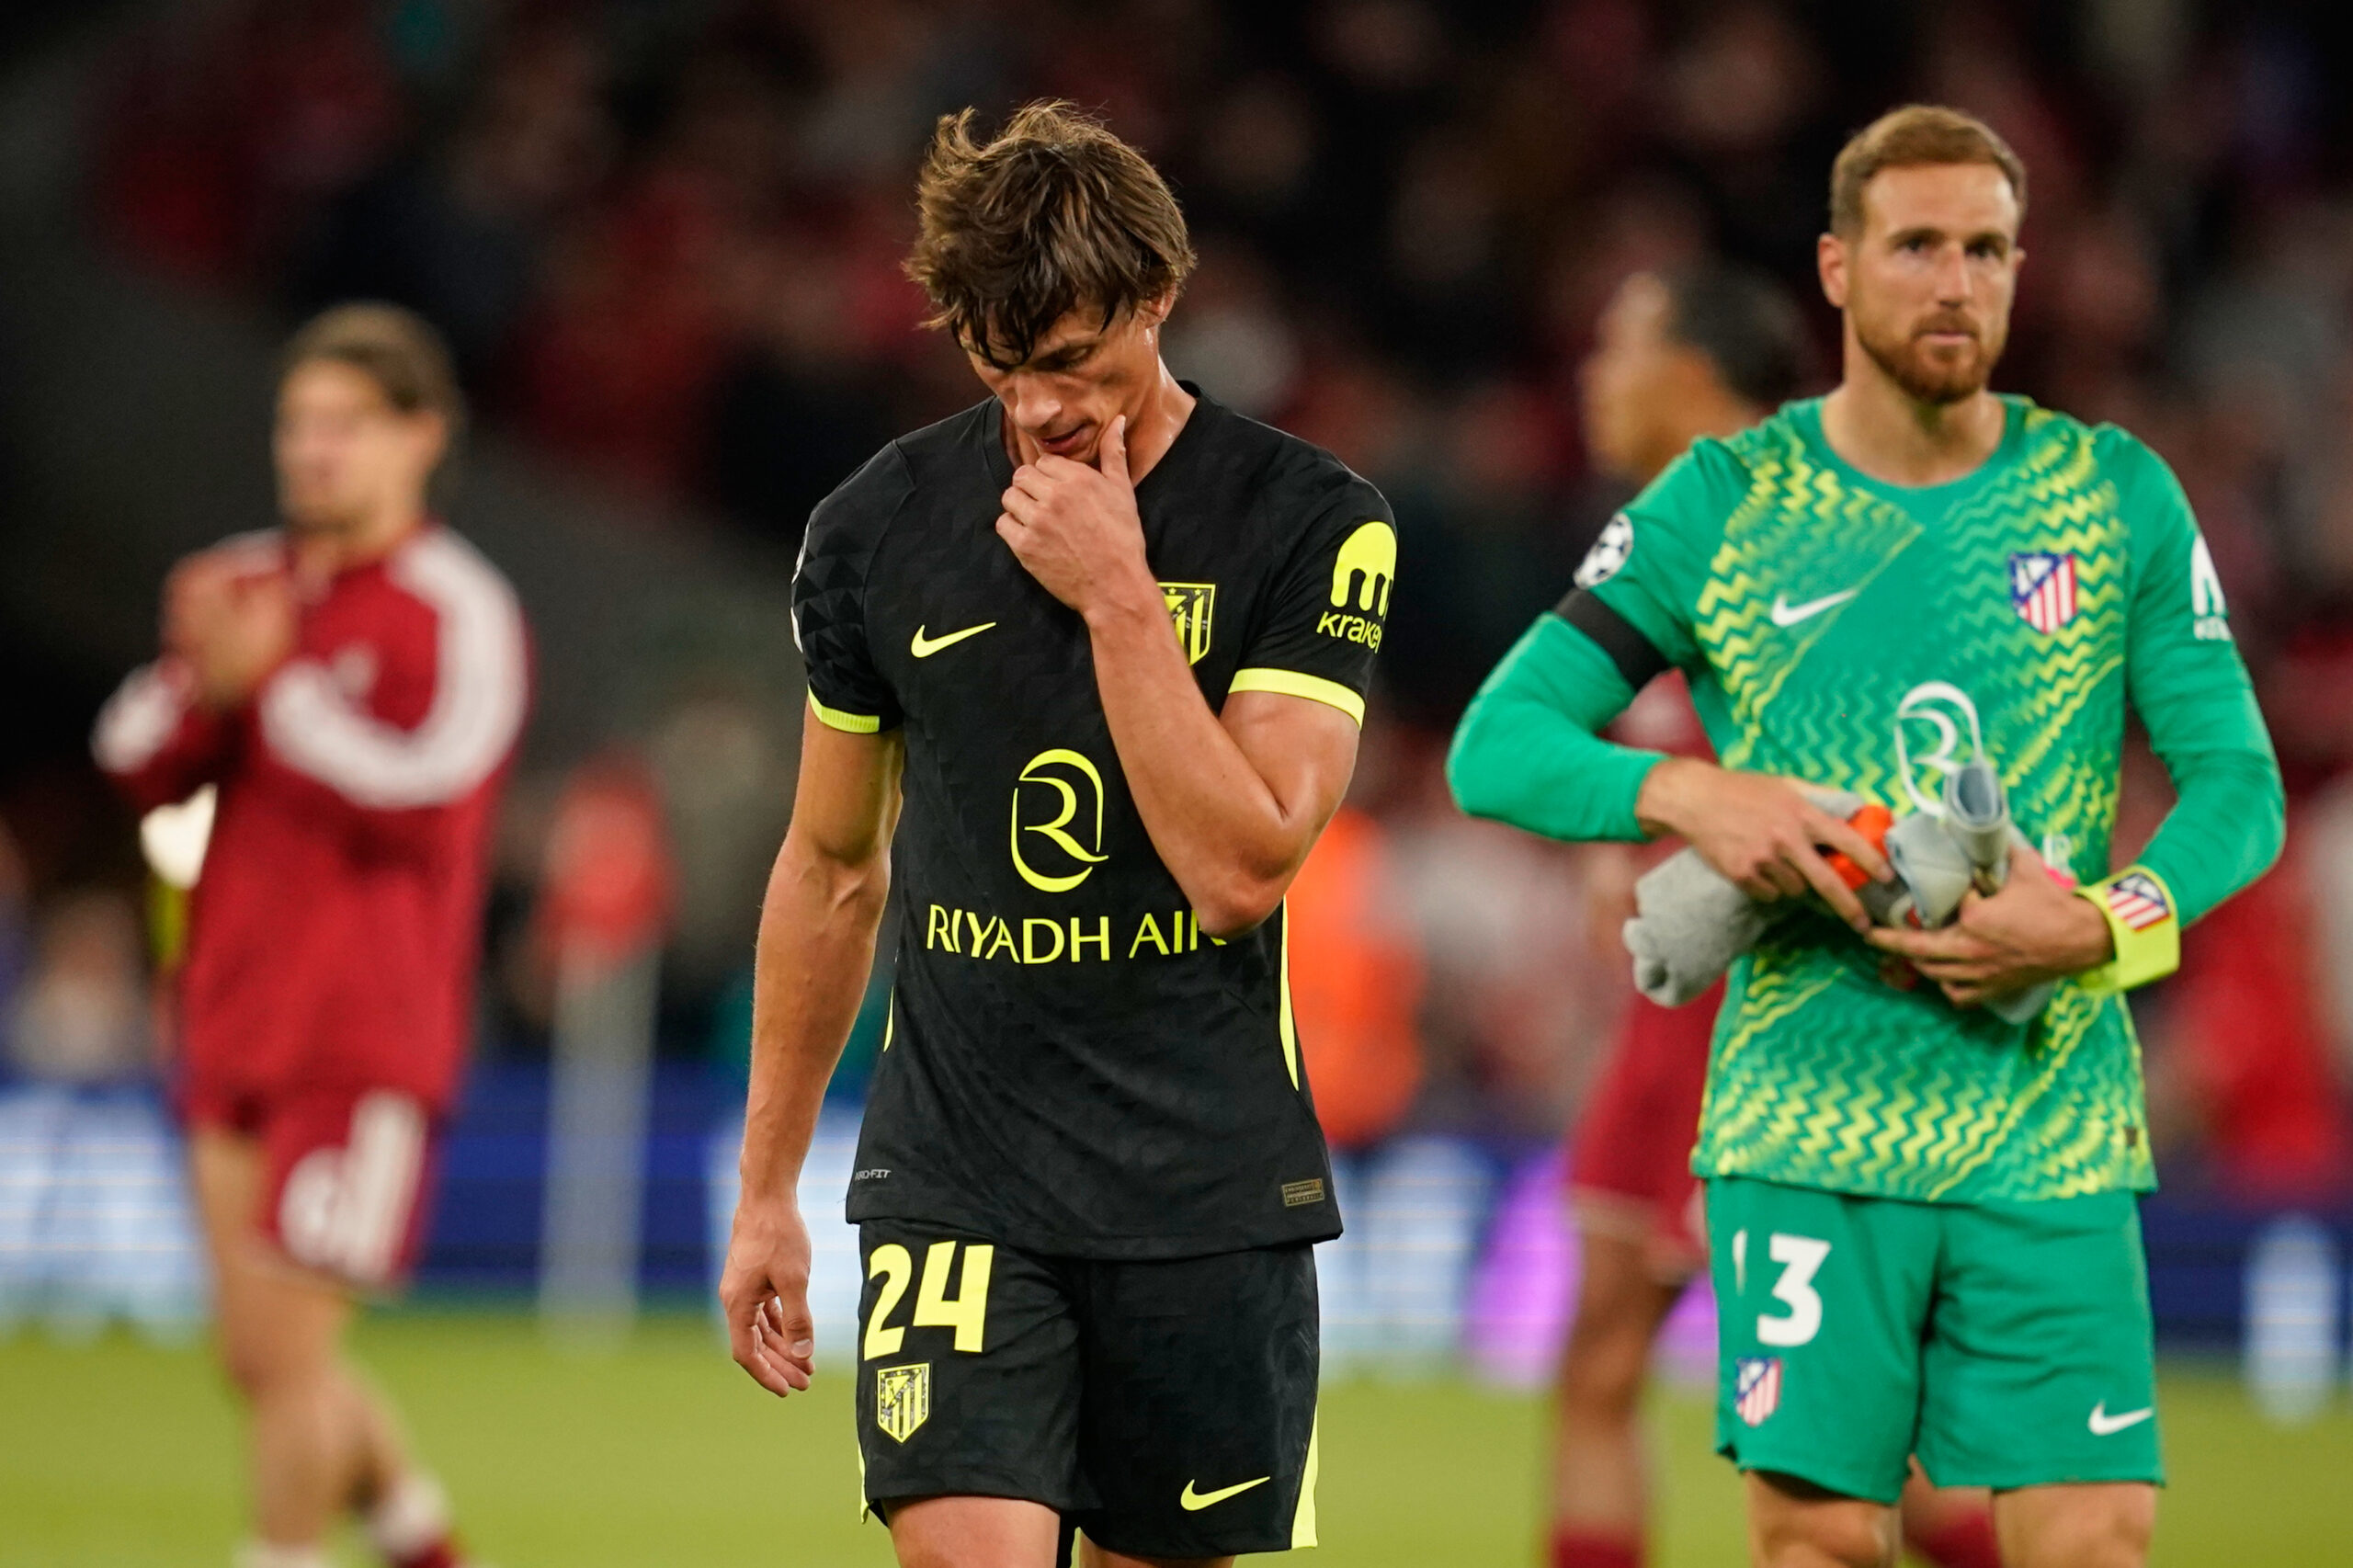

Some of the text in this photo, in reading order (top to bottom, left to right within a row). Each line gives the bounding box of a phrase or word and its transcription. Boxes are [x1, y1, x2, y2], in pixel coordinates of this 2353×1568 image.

[1316, 610, 1382, 654] krake
[926, 903, 1110, 965] RIYADH
[863, 1240, 994, 1361] 24
